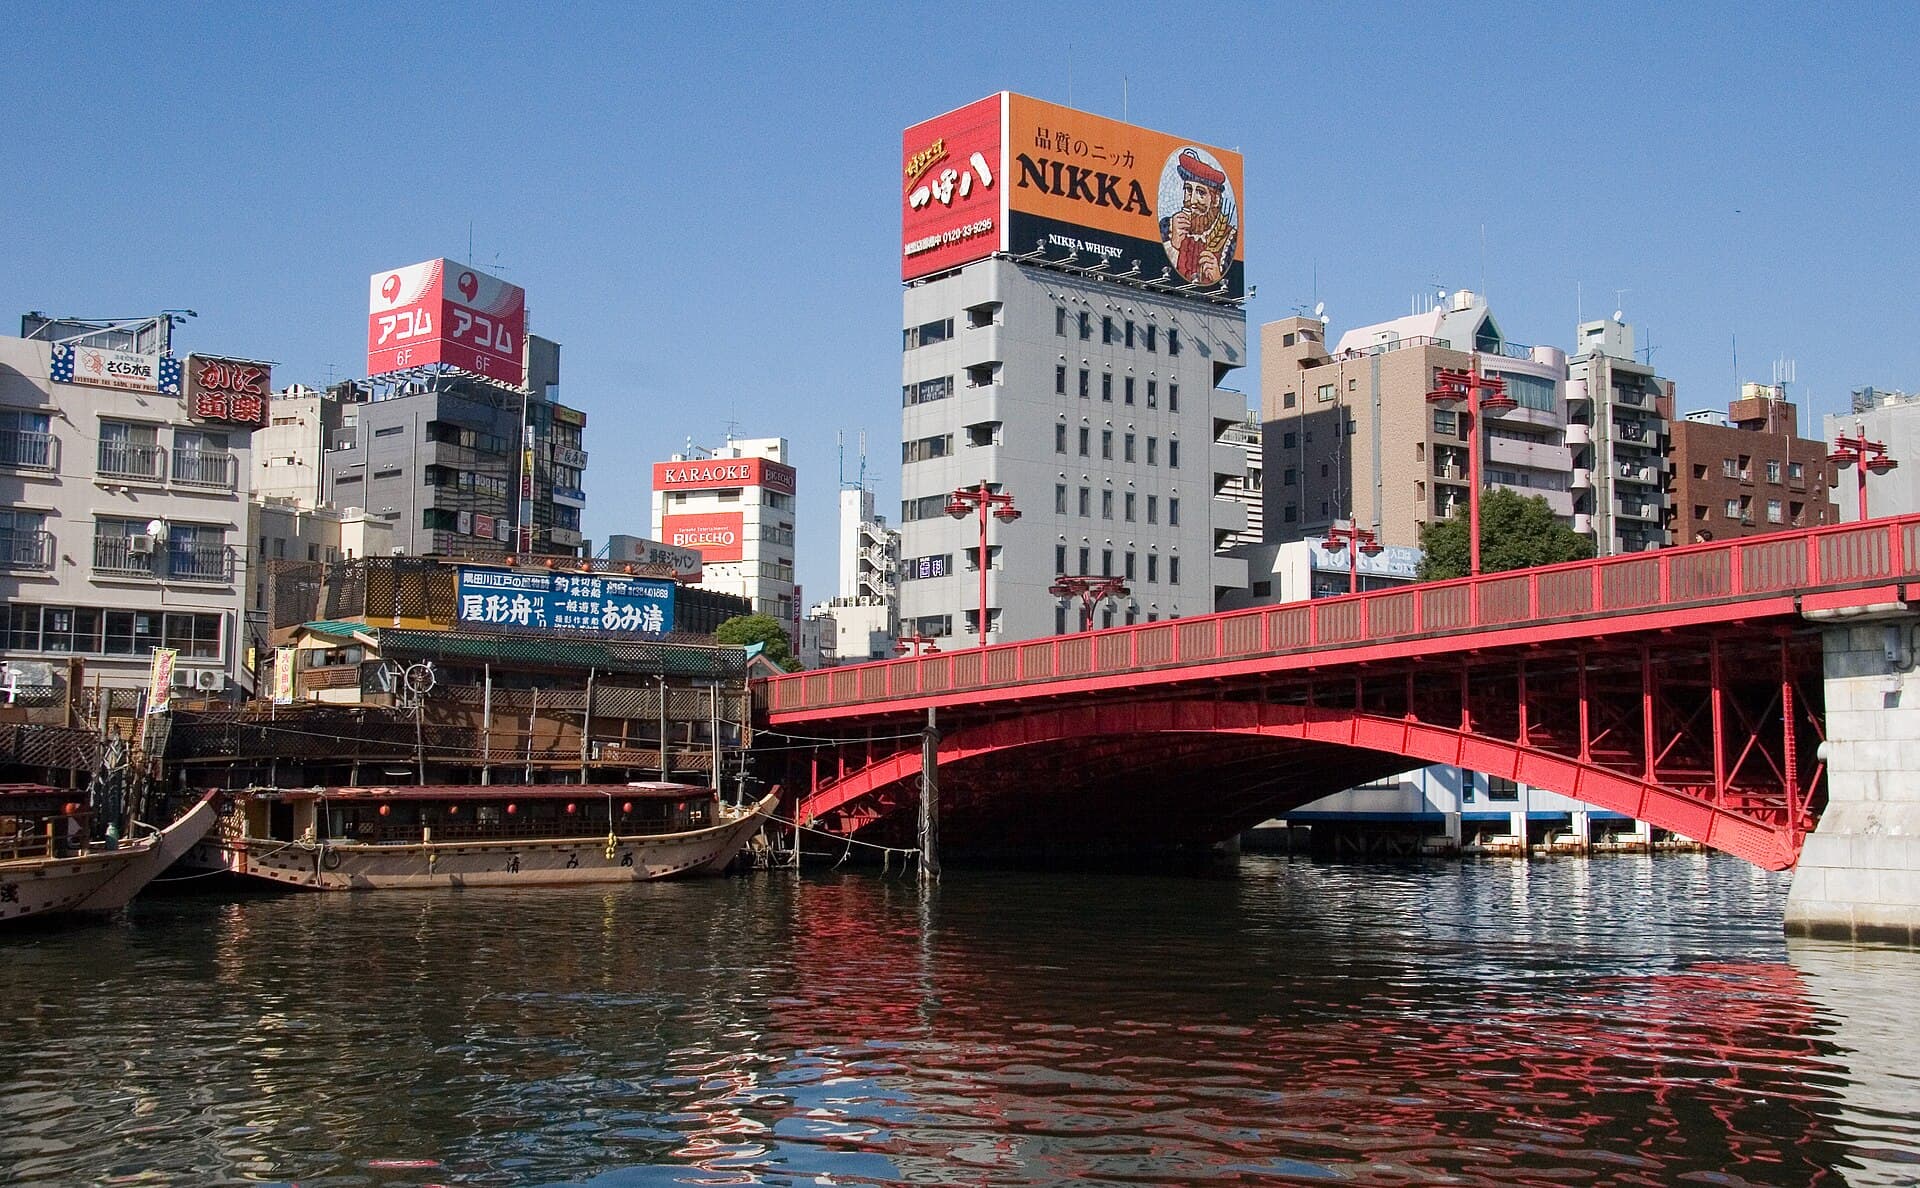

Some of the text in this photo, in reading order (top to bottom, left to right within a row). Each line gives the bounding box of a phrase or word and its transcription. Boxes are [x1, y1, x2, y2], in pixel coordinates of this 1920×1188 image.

[1034, 126, 1136, 169] 品質のニッカ
[909, 151, 993, 209] つぼ八
[1015, 152, 1153, 217] NIKKA
[942, 217, 992, 243] 0120-33-9295
[1048, 233, 1123, 258] NIKKA WHISKY
[377, 307, 433, 345] アコム
[452, 308, 513, 355] アコム
[107, 360, 152, 377] さくら水産
[396, 348, 412, 366] 6F
[475, 355, 491, 372] 6F
[198, 360, 262, 395] かに
[196, 391, 262, 423] 道楽
[664, 464, 751, 483] KARAOKE
[765, 469, 794, 488] BIG ECHO
[673, 531, 735, 546] BIG ECHO
[461, 594, 532, 626] 屋形舟
[601, 599, 664, 635] あみ清
